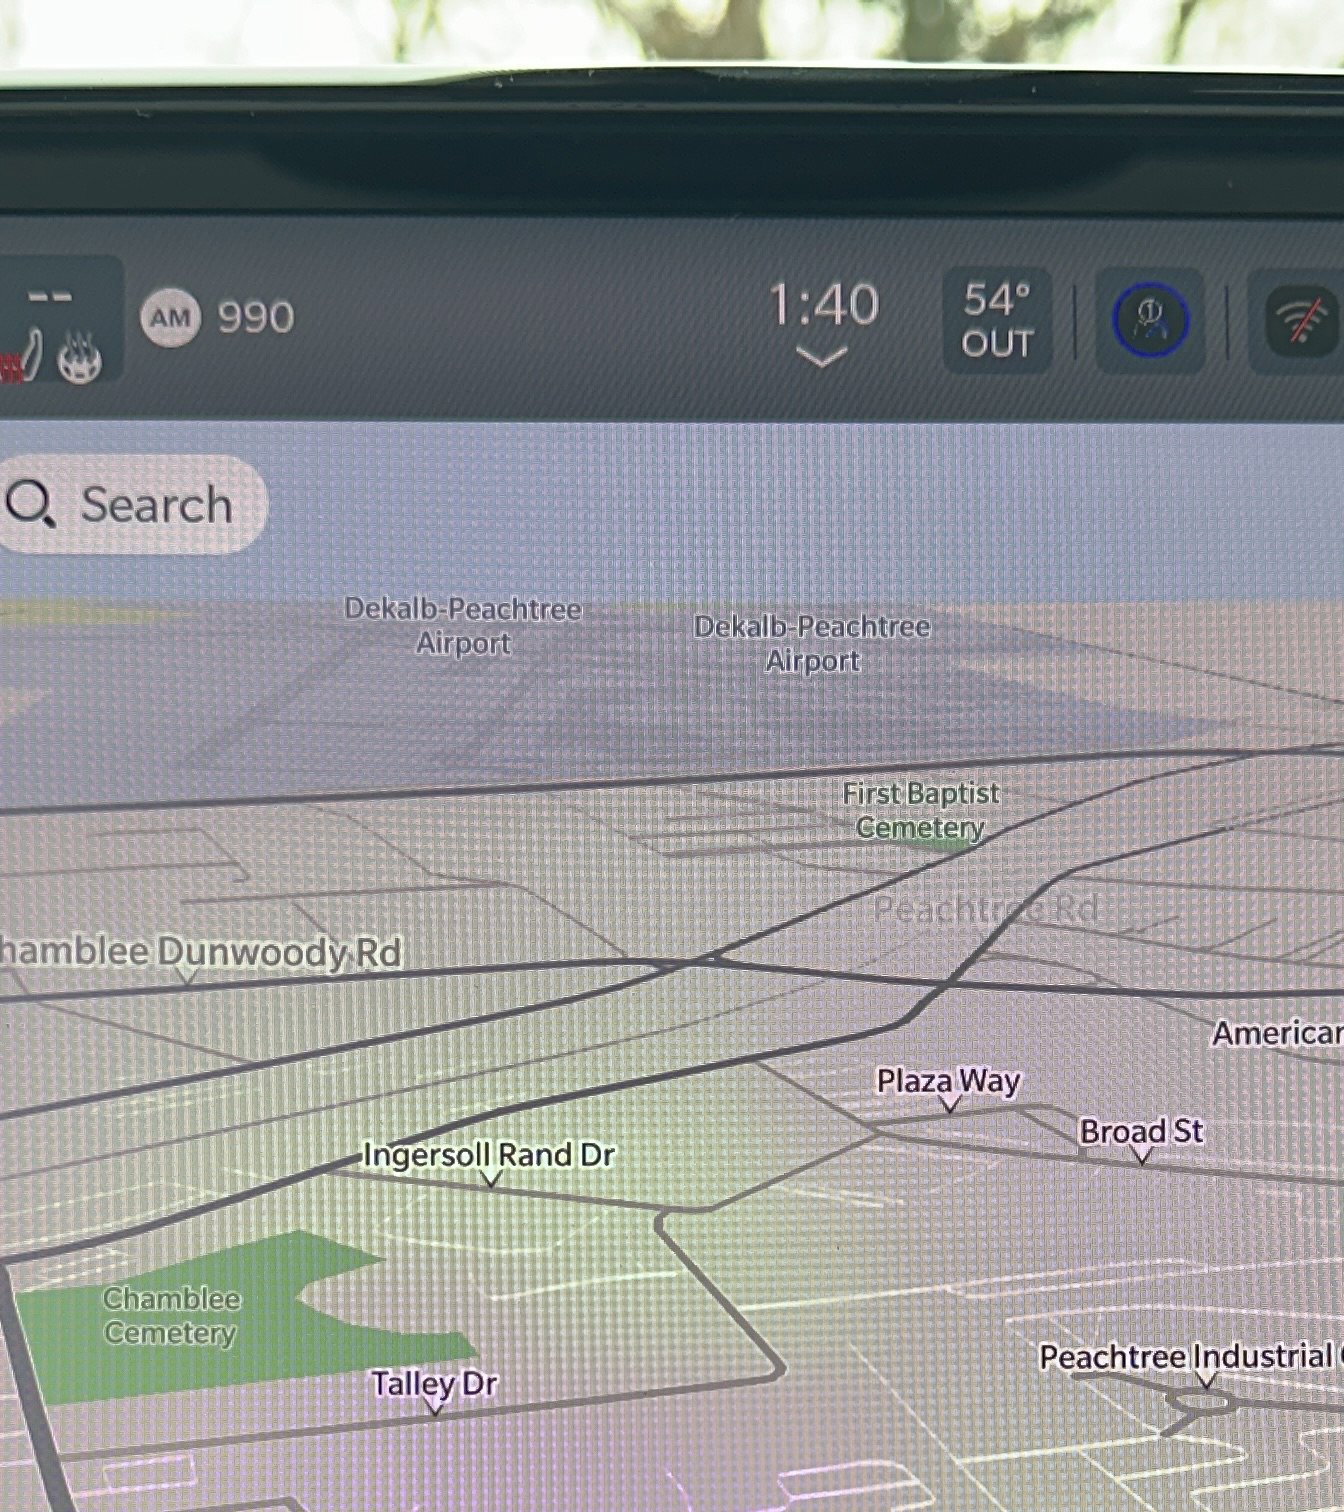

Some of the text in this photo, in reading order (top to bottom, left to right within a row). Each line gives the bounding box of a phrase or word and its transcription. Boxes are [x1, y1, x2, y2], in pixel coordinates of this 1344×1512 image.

[770, 281, 879, 327] 1:40
[964, 281, 1031, 316] 54°
[151, 301, 294, 334] AM 990
[962, 328, 1035, 358] OUT
[82, 483, 233, 525] Search
[345, 596, 582, 622] Dekalb-Peachtree
[694, 613, 931, 640] Dekalb-Peachtree
[416, 631, 511, 658] Airport
[766, 648, 860, 676] Airport
[843, 782, 1001, 812] First Baptist
[855, 814, 986, 845] Cemetery
[1057, 893, 1098, 921] Rd
[159, 935, 346, 972] Dunwoody
[358, 937, 401, 967] Rd
[877, 1067, 1021, 1098] Plaza Way
[1081, 1117, 1204, 1145] Broad St
[364, 1141, 615, 1173] Ingersoll Rand Dr
[103, 1287, 241, 1313] Chamblee
[103, 1320, 237, 1349] Cemetery
[1039, 1342, 1186, 1370] Peachtree
[1194, 1342, 1332, 1369] Industrial
[371, 1370, 497, 1400] Talley Dr
